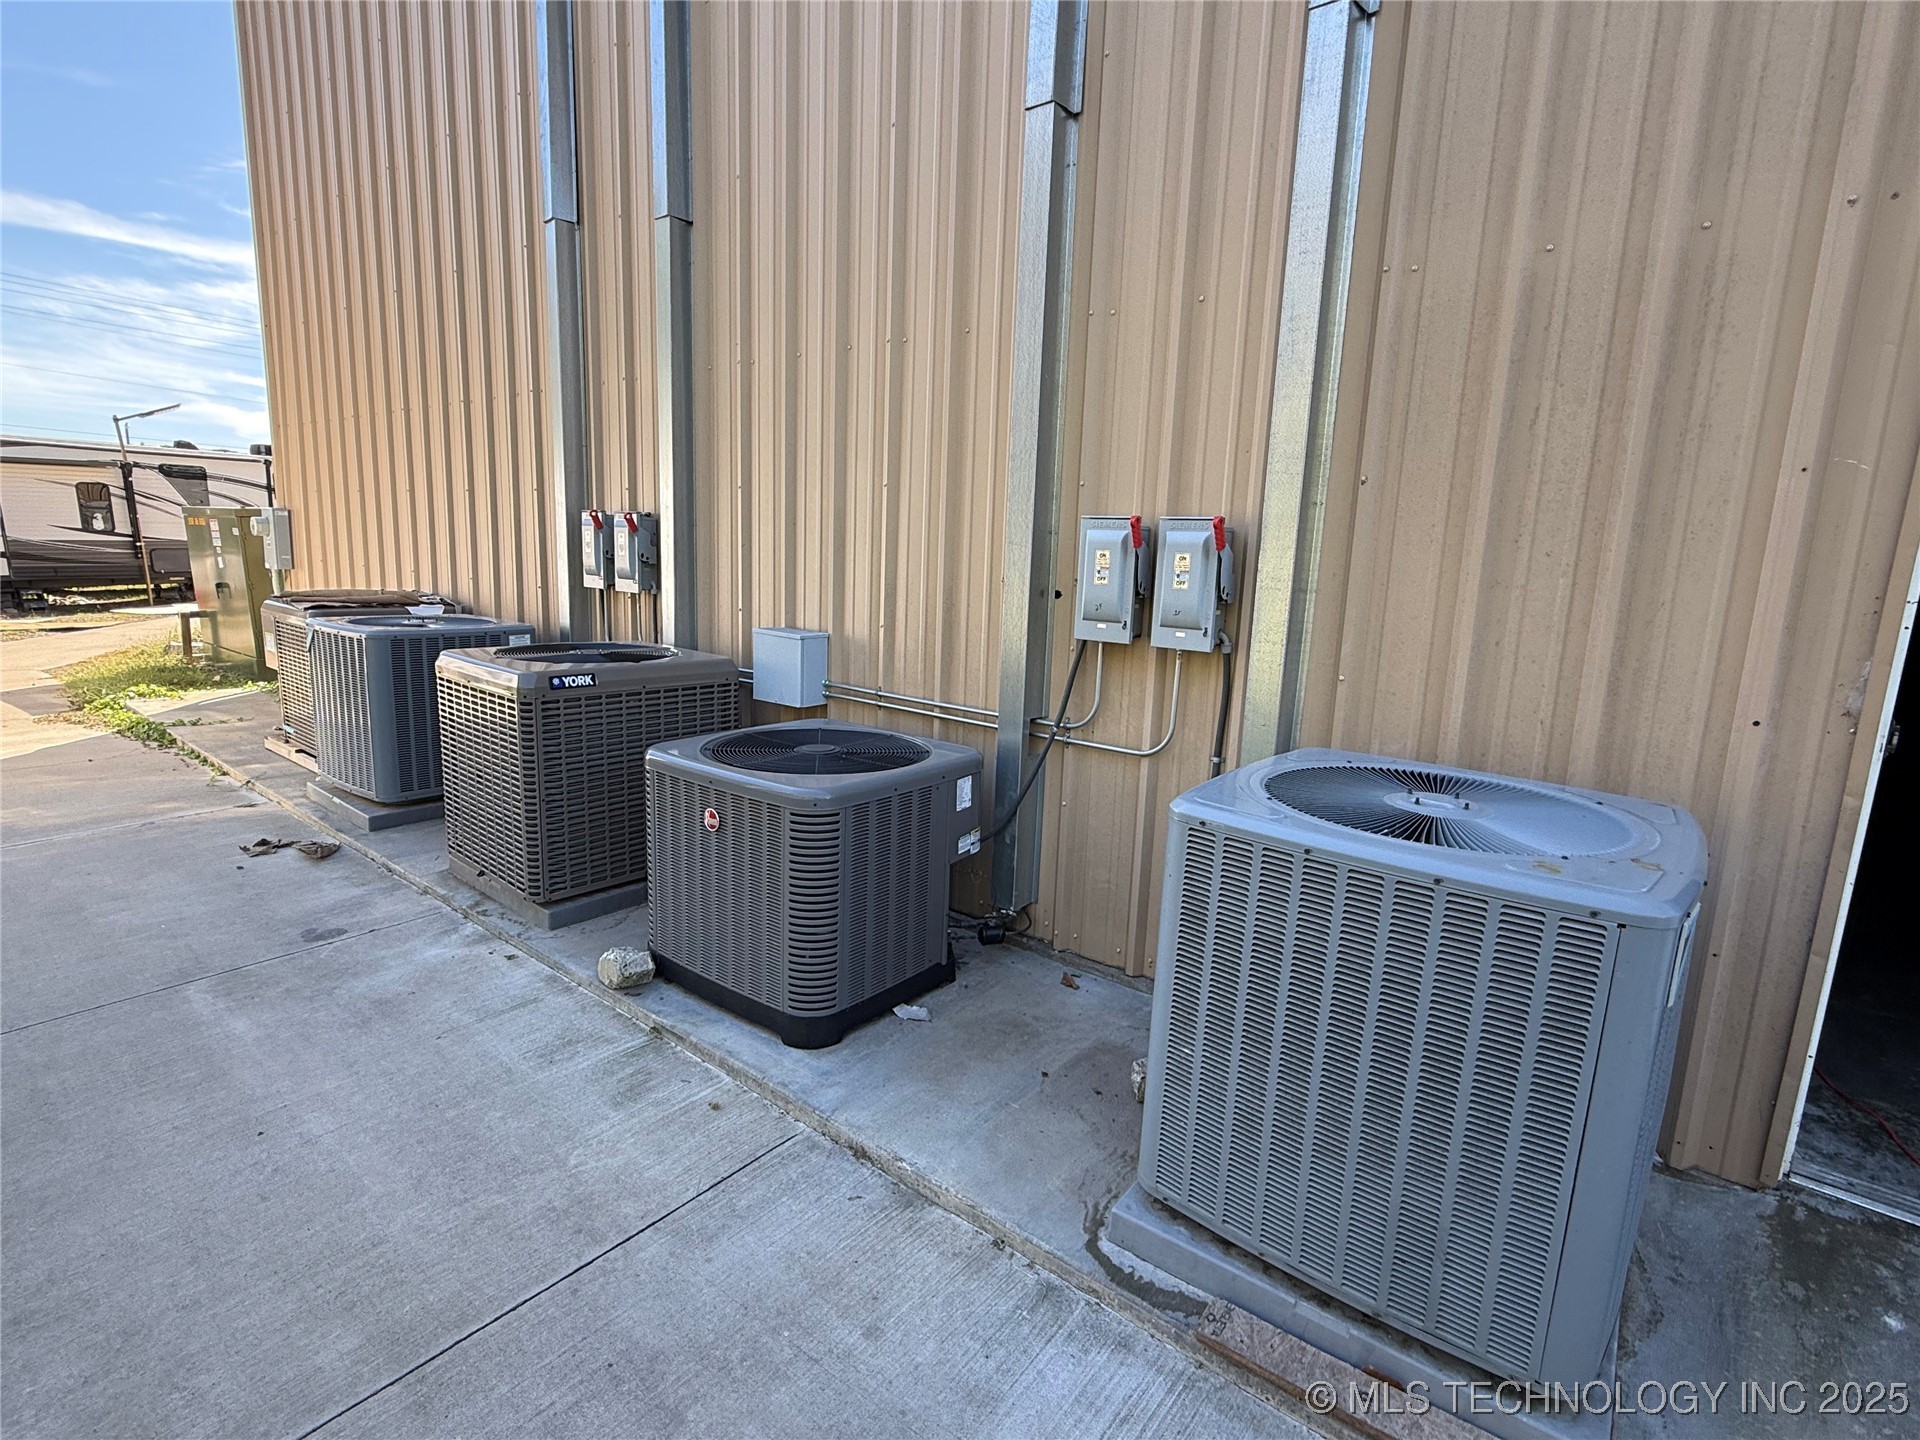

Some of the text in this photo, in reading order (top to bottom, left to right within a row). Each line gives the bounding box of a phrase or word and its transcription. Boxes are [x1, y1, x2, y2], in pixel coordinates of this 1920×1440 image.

[1090, 520, 1128, 529] SIEMENS
[1170, 521, 1209, 530] SIEMENS
[562, 674, 594, 687] YORK
